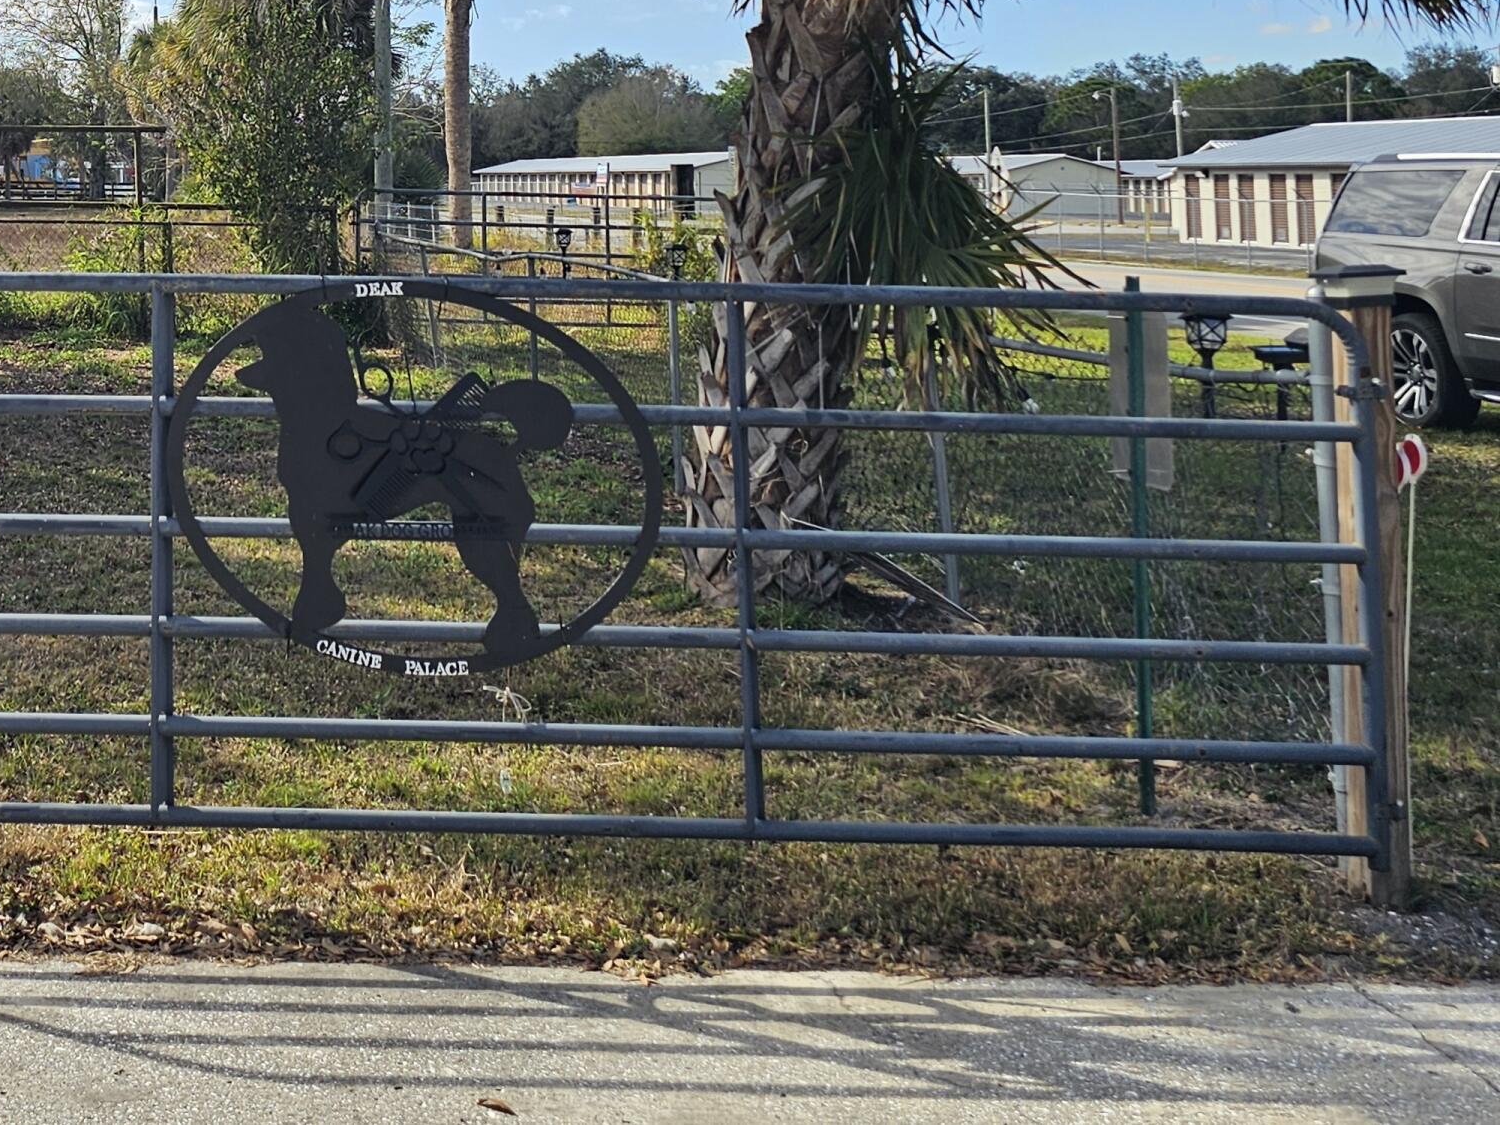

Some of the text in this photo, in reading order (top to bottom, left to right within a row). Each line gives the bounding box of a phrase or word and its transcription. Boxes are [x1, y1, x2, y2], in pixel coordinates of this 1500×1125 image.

[355, 281, 404, 297] DEAK
[316, 639, 469, 676] CANINE PALACE
